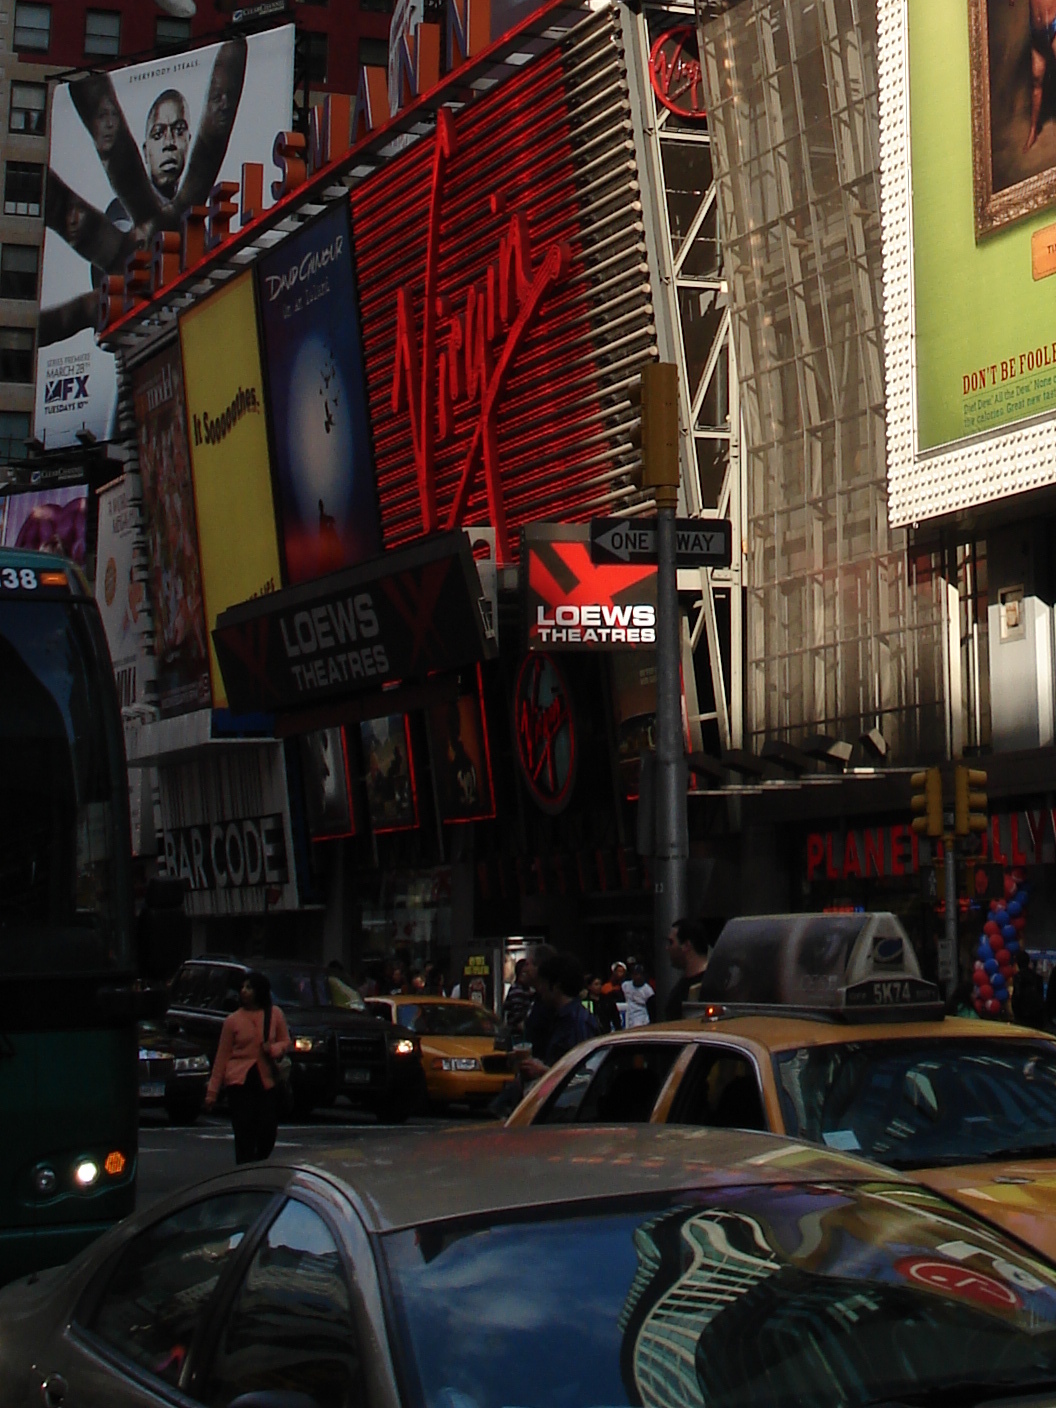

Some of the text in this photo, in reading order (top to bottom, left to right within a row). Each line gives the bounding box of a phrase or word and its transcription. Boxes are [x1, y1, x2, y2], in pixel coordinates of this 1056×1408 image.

[392, 107, 571, 565] Virgin
[962, 365, 997, 395] DON'T
[1001, 356, 1016, 382] BE
[611, 532, 714, 551] ONE WAY
[279, 593, 380, 658] LOEWS
[536, 604, 656, 627] LOEWS
[537, 628, 656, 643] THEATRES
[291, 644, 390, 691] THEATRES
[165, 816, 282, 890] BAR CODE
[873, 982, 911, 1004] 5K74
